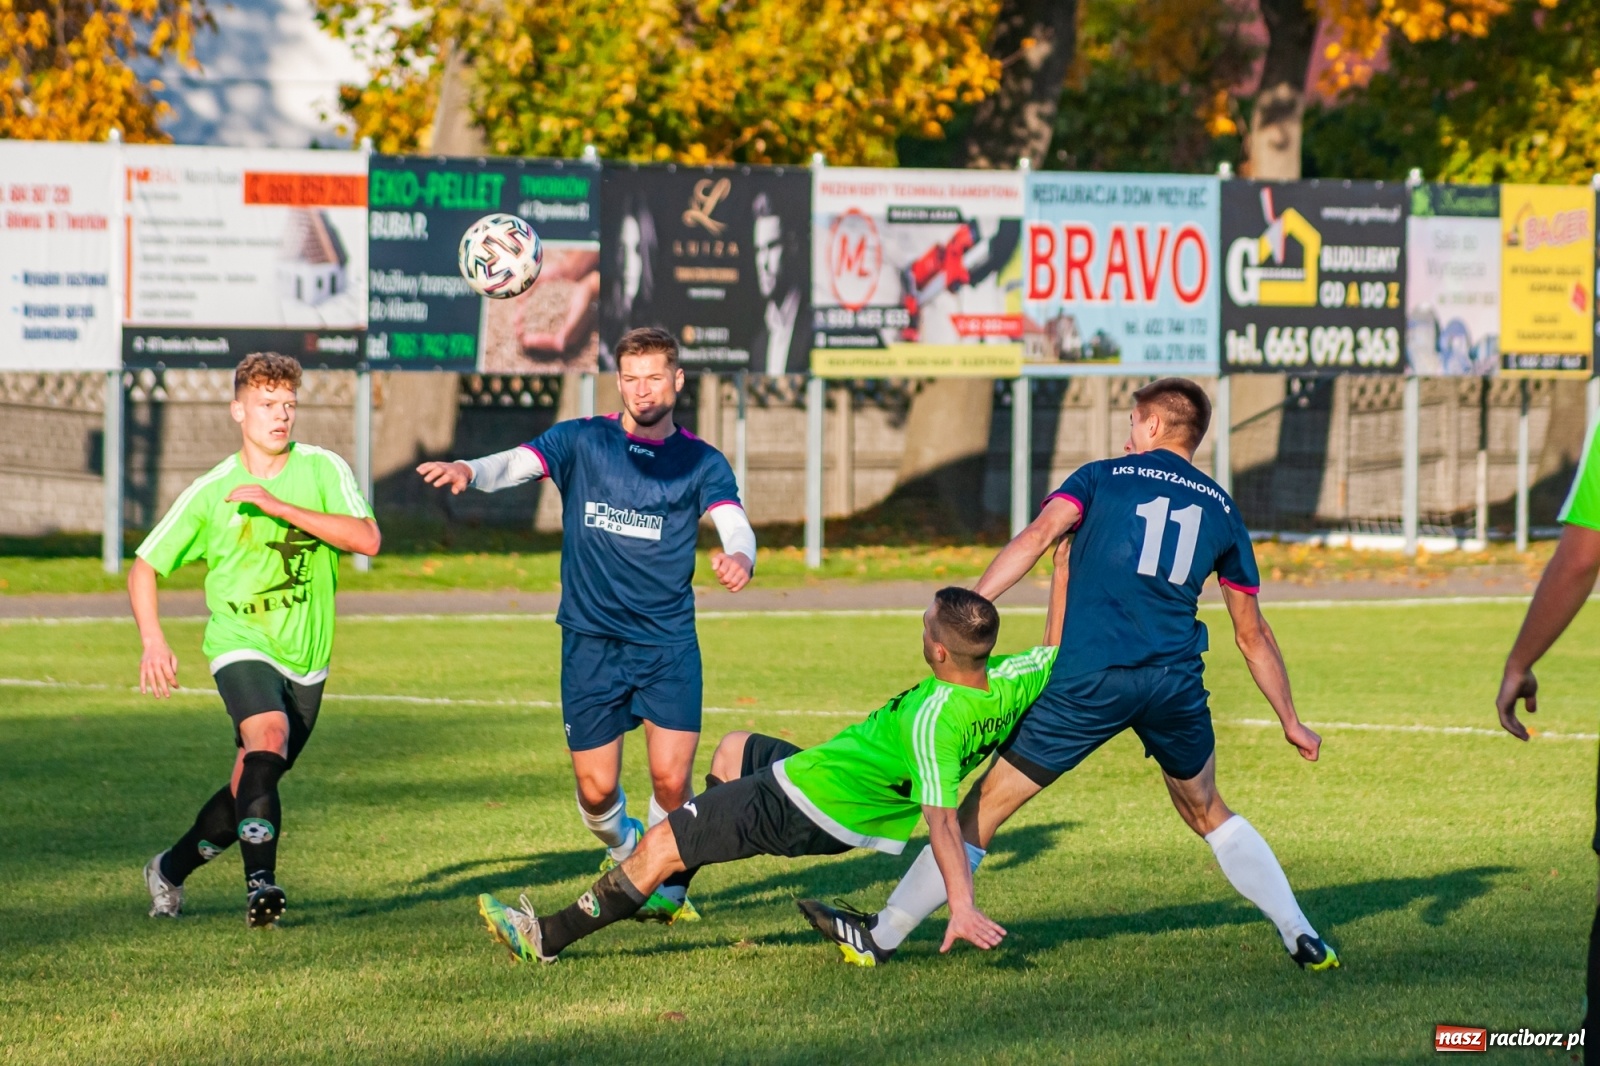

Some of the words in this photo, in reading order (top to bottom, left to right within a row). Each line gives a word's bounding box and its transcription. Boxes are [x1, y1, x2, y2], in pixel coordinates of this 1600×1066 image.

[371, 170, 506, 209] EKO-PELLET
[1028, 225, 1208, 303] BRAVO
[1320, 245, 1400, 272] BUDUJEMY
[1319, 281, 1346, 308] OD
[1346, 281, 1361, 307] A
[1361, 281, 1387, 308] DO
[1387, 282, 1400, 308] Z
[1225, 323, 1263, 365] tel.
[1264, 326, 1309, 366] 665
[1310, 326, 1355, 366] 092
[1356, 326, 1400, 366] 363
[599, 520, 622, 532] PRD
[608, 507, 663, 530] KÜHN
[1136, 496, 1203, 586] 11
